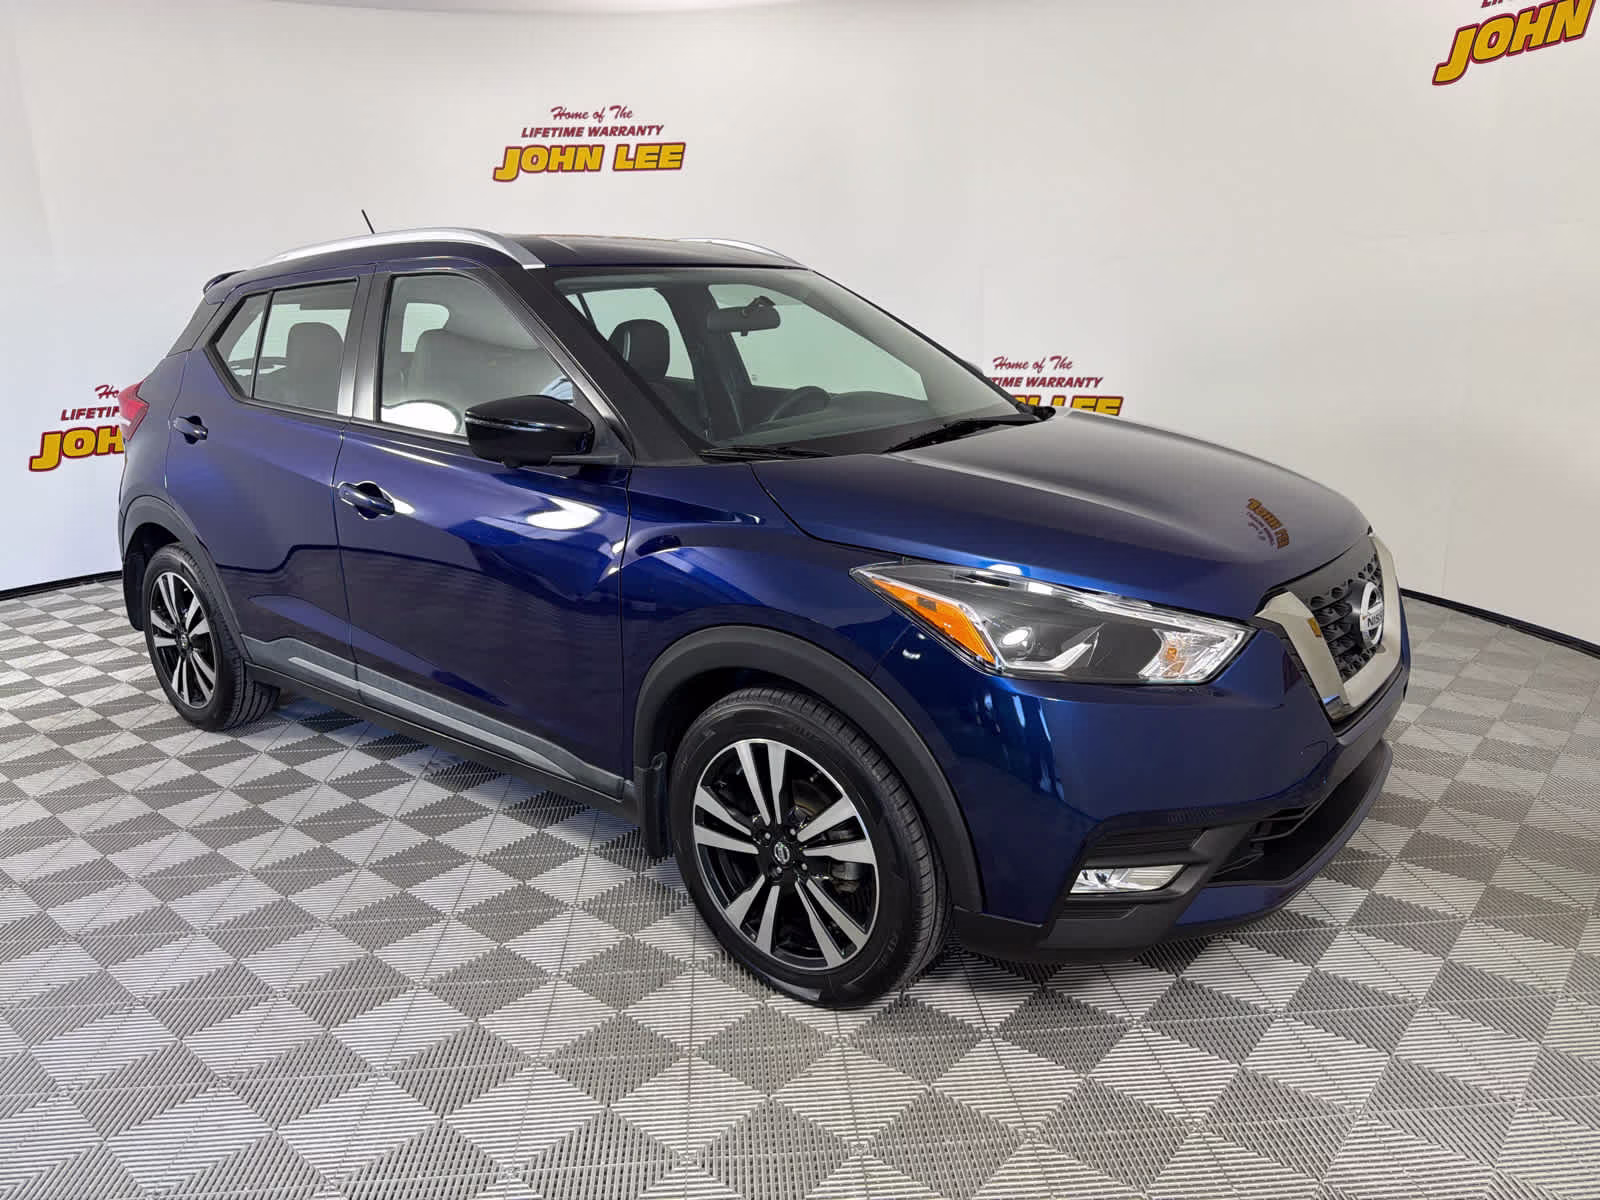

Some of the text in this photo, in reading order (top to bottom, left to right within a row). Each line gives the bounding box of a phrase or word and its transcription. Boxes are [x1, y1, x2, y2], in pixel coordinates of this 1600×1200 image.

[1432, 0, 1596, 86] JOHN
[551, 105, 634, 123] Home of The
[521, 125, 664, 138] LIFETIME WARRANTY
[493, 142, 686, 182] JOHN LEE
[992, 355, 1073, 373] Home of The
[1026, 377, 1104, 388] WARRANTY
[29, 425, 124, 472] JOH
